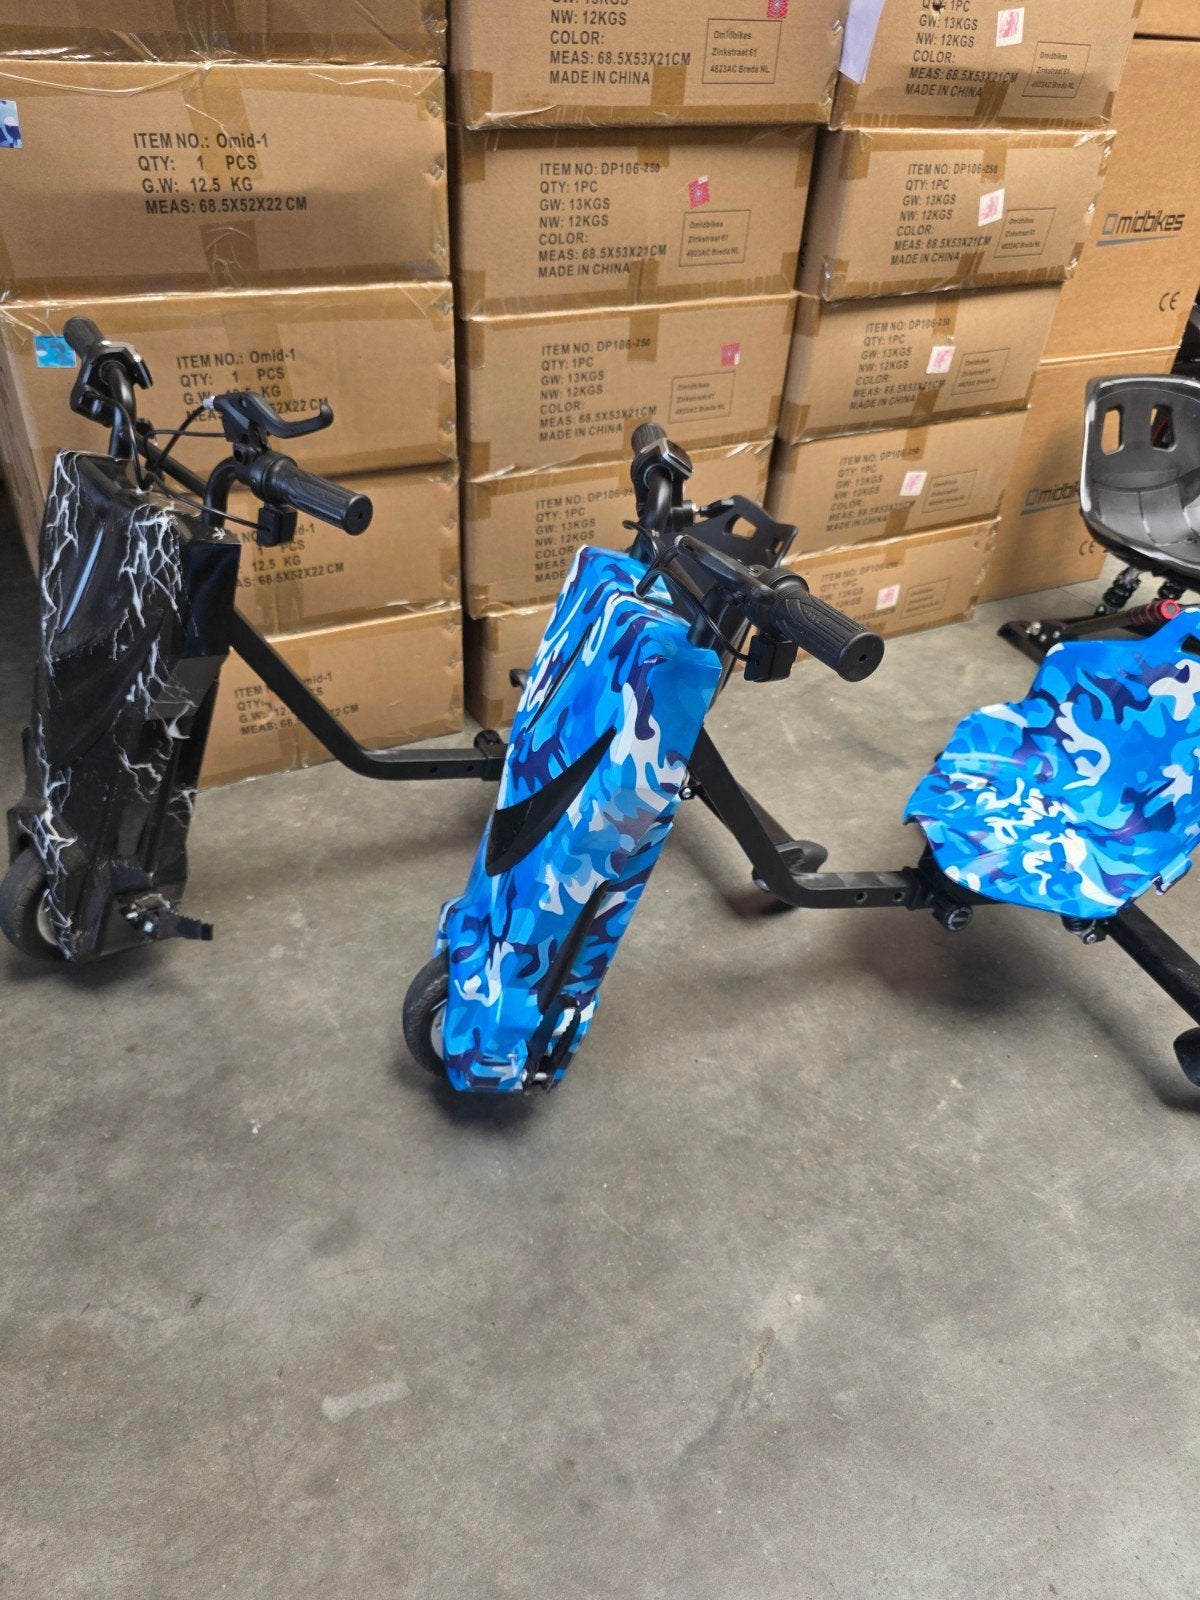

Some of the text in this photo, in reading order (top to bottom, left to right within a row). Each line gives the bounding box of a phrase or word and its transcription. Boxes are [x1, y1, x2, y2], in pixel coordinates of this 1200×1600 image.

[550, 9, 627, 26] NW: 12KGS
[920, 14, 978, 31] GW: 13KGS
[550, 30, 604, 45] COLOR:
[713, 30, 752, 39] Omidbikes
[916, 32, 975, 48] NW: 12KGS
[550, 50, 691, 66] MEAS: 68.5X53X21CM
[712, 48, 748, 56] Zinkstraat
[913, 50, 957, 64] COLOR:
[760, 65, 769, 73] NL
[909, 67, 1019, 83] MEAS: 68.5X53X21CM
[550, 70, 650, 85] MADE IN CHINA
[904, 84, 983, 97] MADE IN CHINA
[134, 132, 268, 149] ITEM NO.: Omid-1
[138, 155, 257, 171] QTY: 1 PCS
[540, 162, 661, 175] ITEM NO: DP106-250
[908, 164, 932, 175] ITEM
[934, 163, 951, 175] NO:
[142, 176, 252, 193] G.W: 12.5 KG
[540, 180, 598, 193] QTY: 1PC
[905, 179, 949, 191] QTY: 1PC
[145, 196, 307, 214] MEAS: 68.5X52X22 CM
[540, 198, 610, 211] GW: 13KGS
[903, 194, 956, 206] GW: 13KGS
[539, 214, 608, 228] NW: 12KGS
[900, 209, 953, 221] NW: 12KGS
[1101, 209, 1186, 235] Omidbikes
[896, 225, 934, 237] COLOR:
[538, 232, 588, 246] COLOR:
[894, 240, 924, 251] MEAS:
[538, 244, 667, 262] MEAS: 68.5X53X21CM
[891, 252, 960, 265] MADE IN CHINA
[538, 263, 630, 278] MADE IN CHINA
[866, 322, 888, 333] ITEM
[888, 334, 905, 344] 1PC
[542, 338, 651, 356] ITEM NO: DP106-250
[177, 348, 295, 370] ITEM NO.: Omid-1
[541, 357, 594, 372] QTY: 1PC
[180, 367, 285, 388] QTY: 1 PCS
[541, 370, 605, 386] GW: 13KGS
[261, 386, 281, 398] KG
[540, 385, 603, 400] NW: 12KGS
[540, 401, 585, 415] COLOR:
[850, 400, 877, 410] MADE
[888, 395, 915, 406] CHINA
[540, 406, 657, 428] MEAS: 68.5X53X21CM
[540, 423, 623, 442] MADE IN CHINA
[536, 498, 562, 509] ITEM
[535, 508, 585, 523] QTY: 1PC
[535, 518, 595, 535] GW: 13KGS
[535, 530, 594, 547] NW: 12KGS
[280, 540, 305, 553] PCS
[252, 555, 301, 572] 12.5 KG
[258, 566, 325, 585] 68.5X52X22
[327, 562, 344, 574] CM
[535, 571, 566, 582] MADE
[234, 686, 262, 699] ITEM
[343, 704, 359, 715] CM
[241, 721, 278, 735] MEAS:
